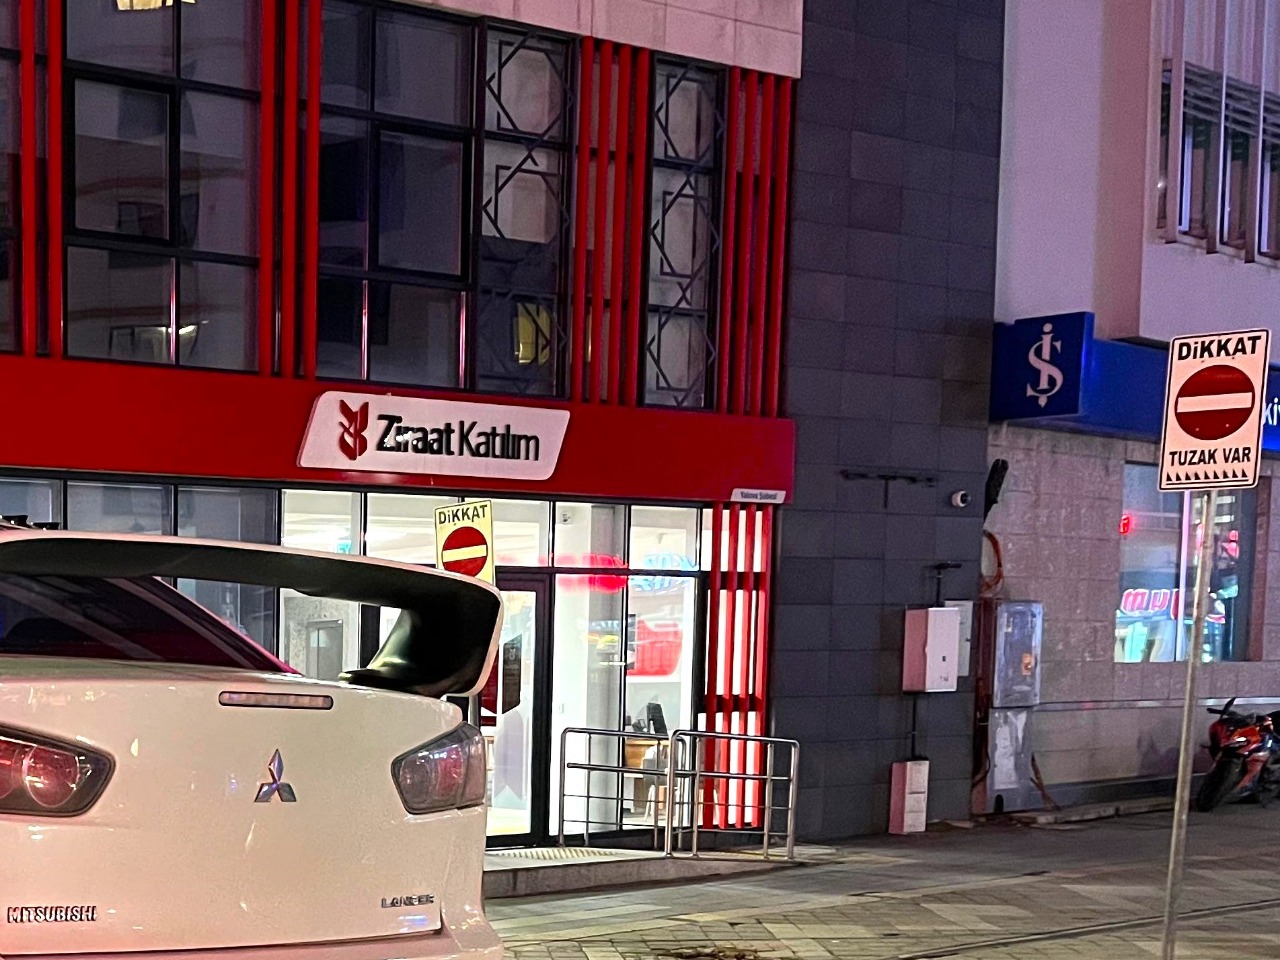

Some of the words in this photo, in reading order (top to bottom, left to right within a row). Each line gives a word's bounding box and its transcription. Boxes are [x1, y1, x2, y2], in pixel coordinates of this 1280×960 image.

[376, 413, 456, 456] Ziraat
[1169, 448, 1218, 467] TUZAK
[1222, 446, 1252, 464] VAR
[7, 905, 97, 924] MITSUBISHI
